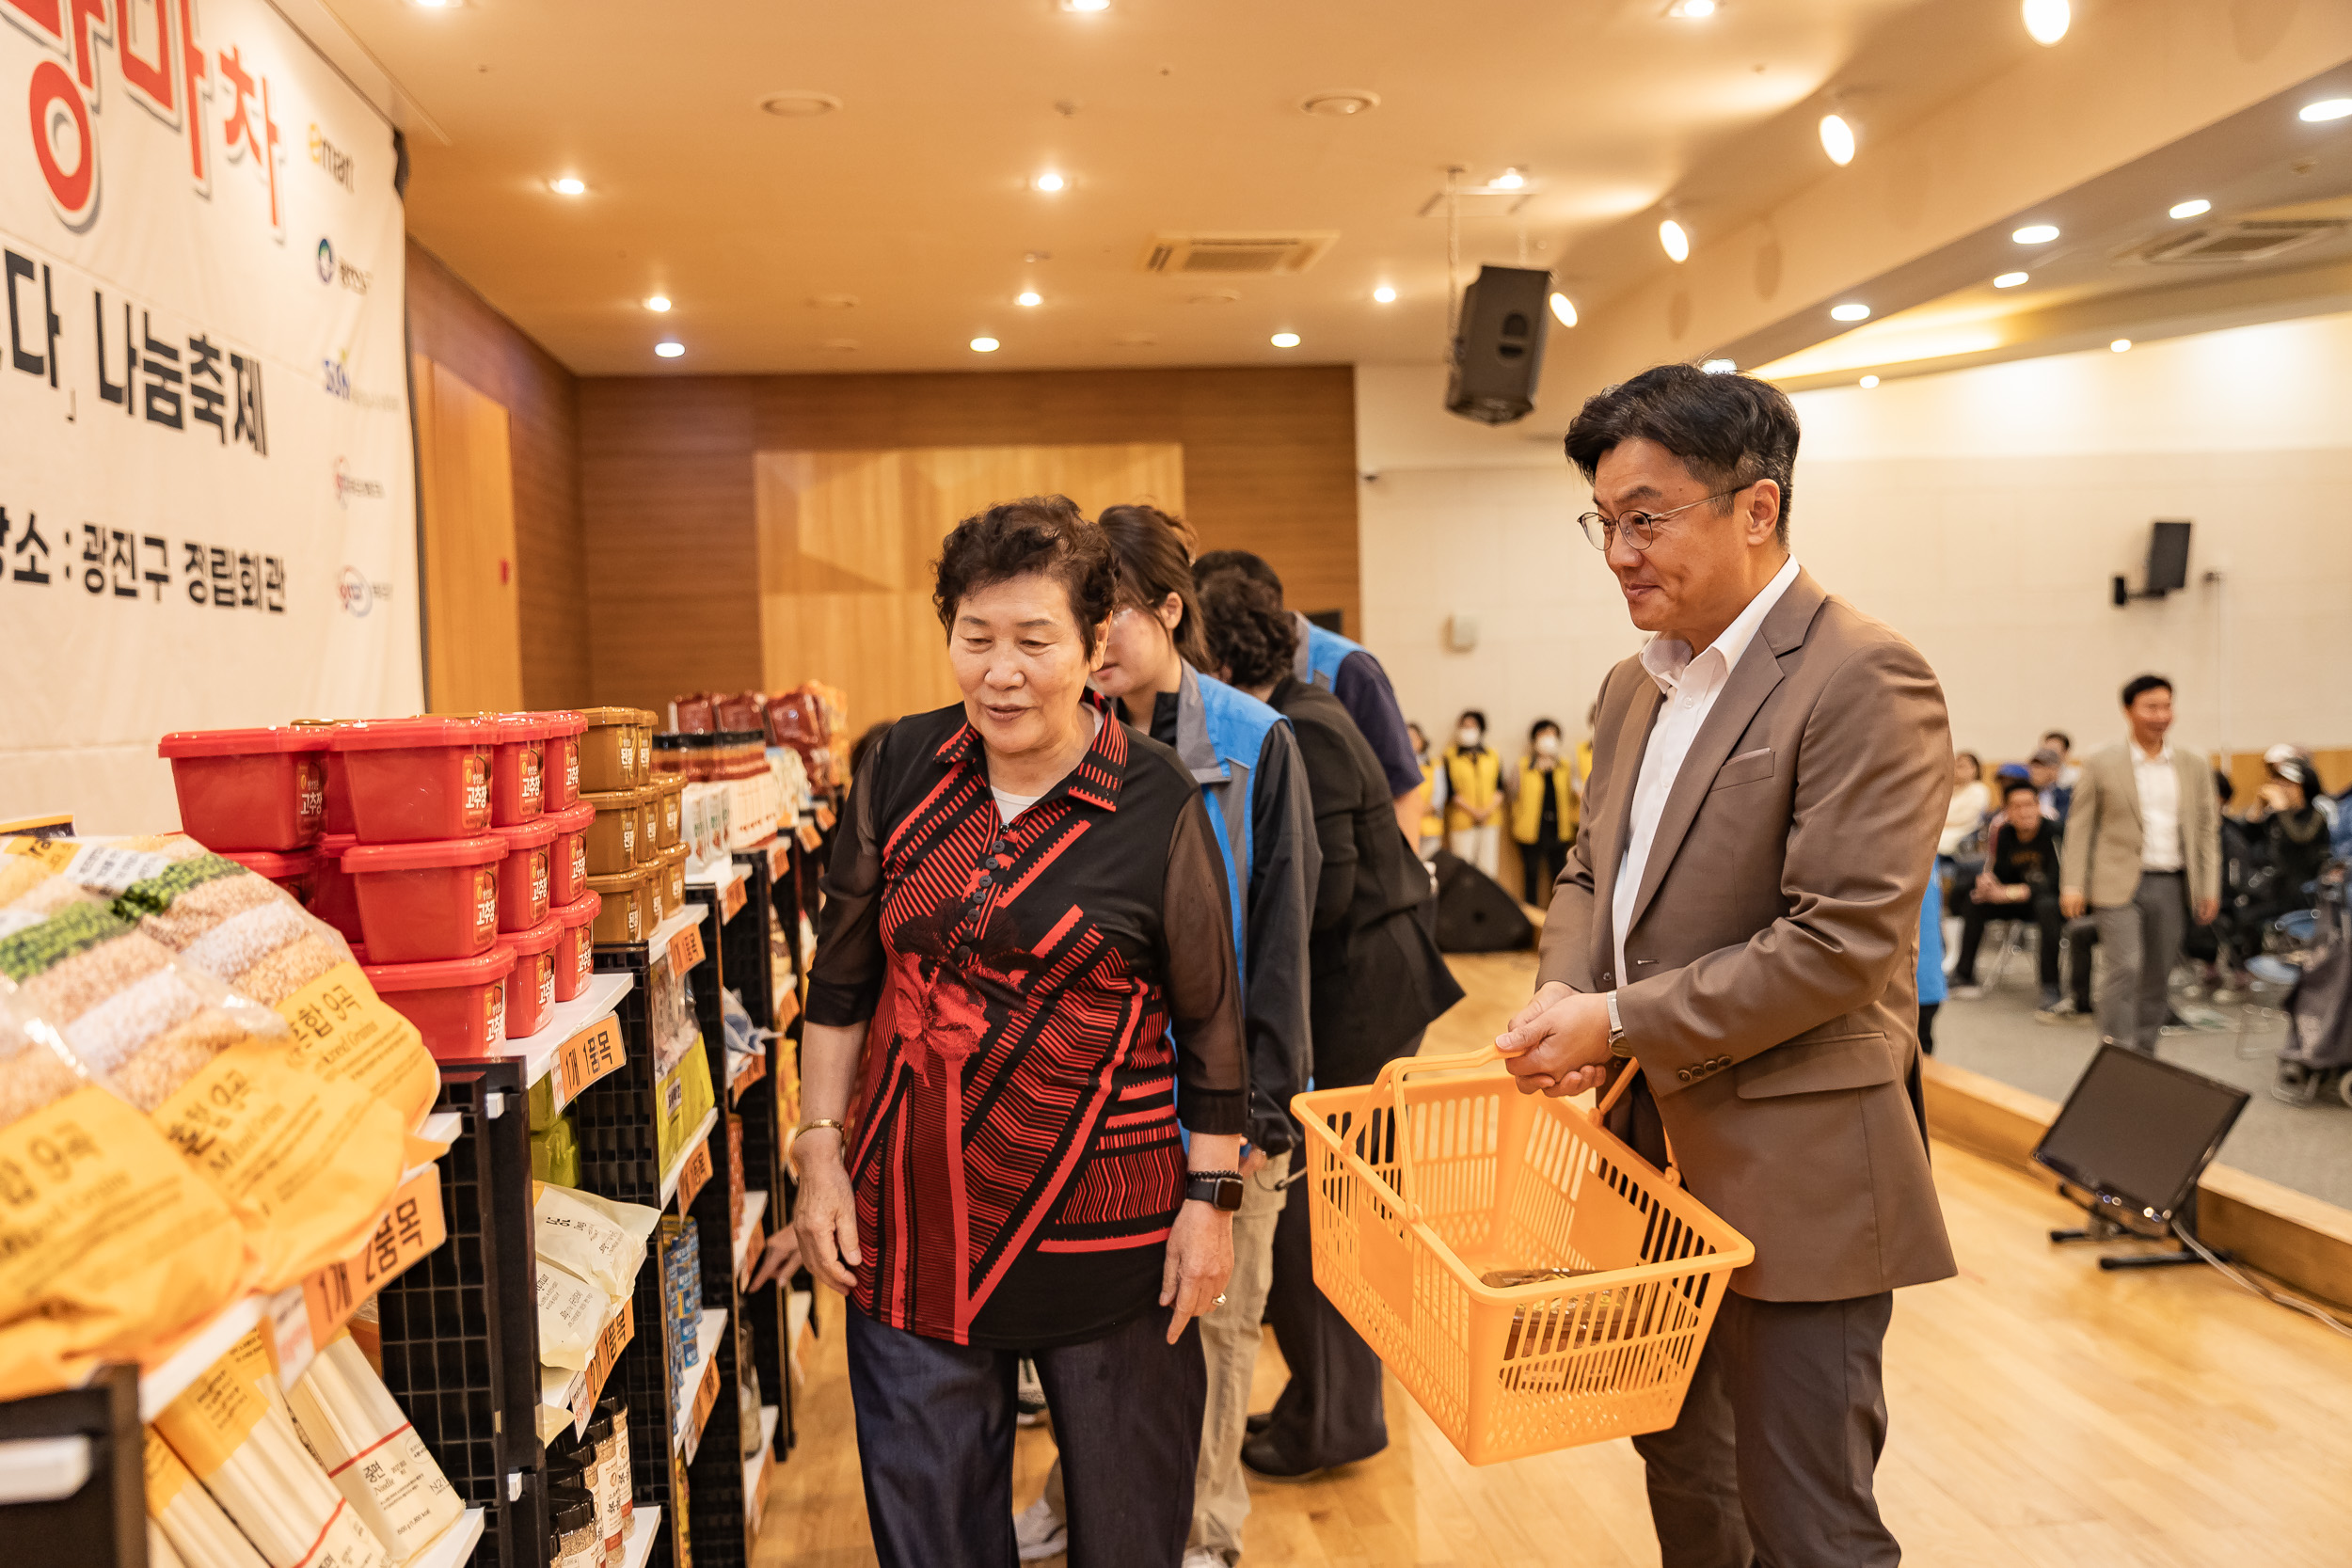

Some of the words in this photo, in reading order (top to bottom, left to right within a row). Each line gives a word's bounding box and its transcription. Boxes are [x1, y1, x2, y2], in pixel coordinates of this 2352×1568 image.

[94, 291, 268, 457] 나눔축제
[83, 523, 170, 603] 광진구
[183, 542, 287, 614] 정립회관
[521, 774, 541, 798] 고추장
[566, 765, 580, 786] 고추장
[300, 791, 323, 816] 고추장
[465, 784, 487, 810] 고추장
[571, 855, 586, 879] 고추장
[532, 876, 548, 902] 고추장
[476, 898, 496, 927] 고추장
[578, 946, 593, 973] 고추장
[565, 1047, 581, 1090] 1개
[582, 1030, 614, 1077] 1품목
[318, 1260, 354, 1324] 1개
[604, 1308, 627, 1367] 1품목
[363, 1460, 386, 1483] 중면
